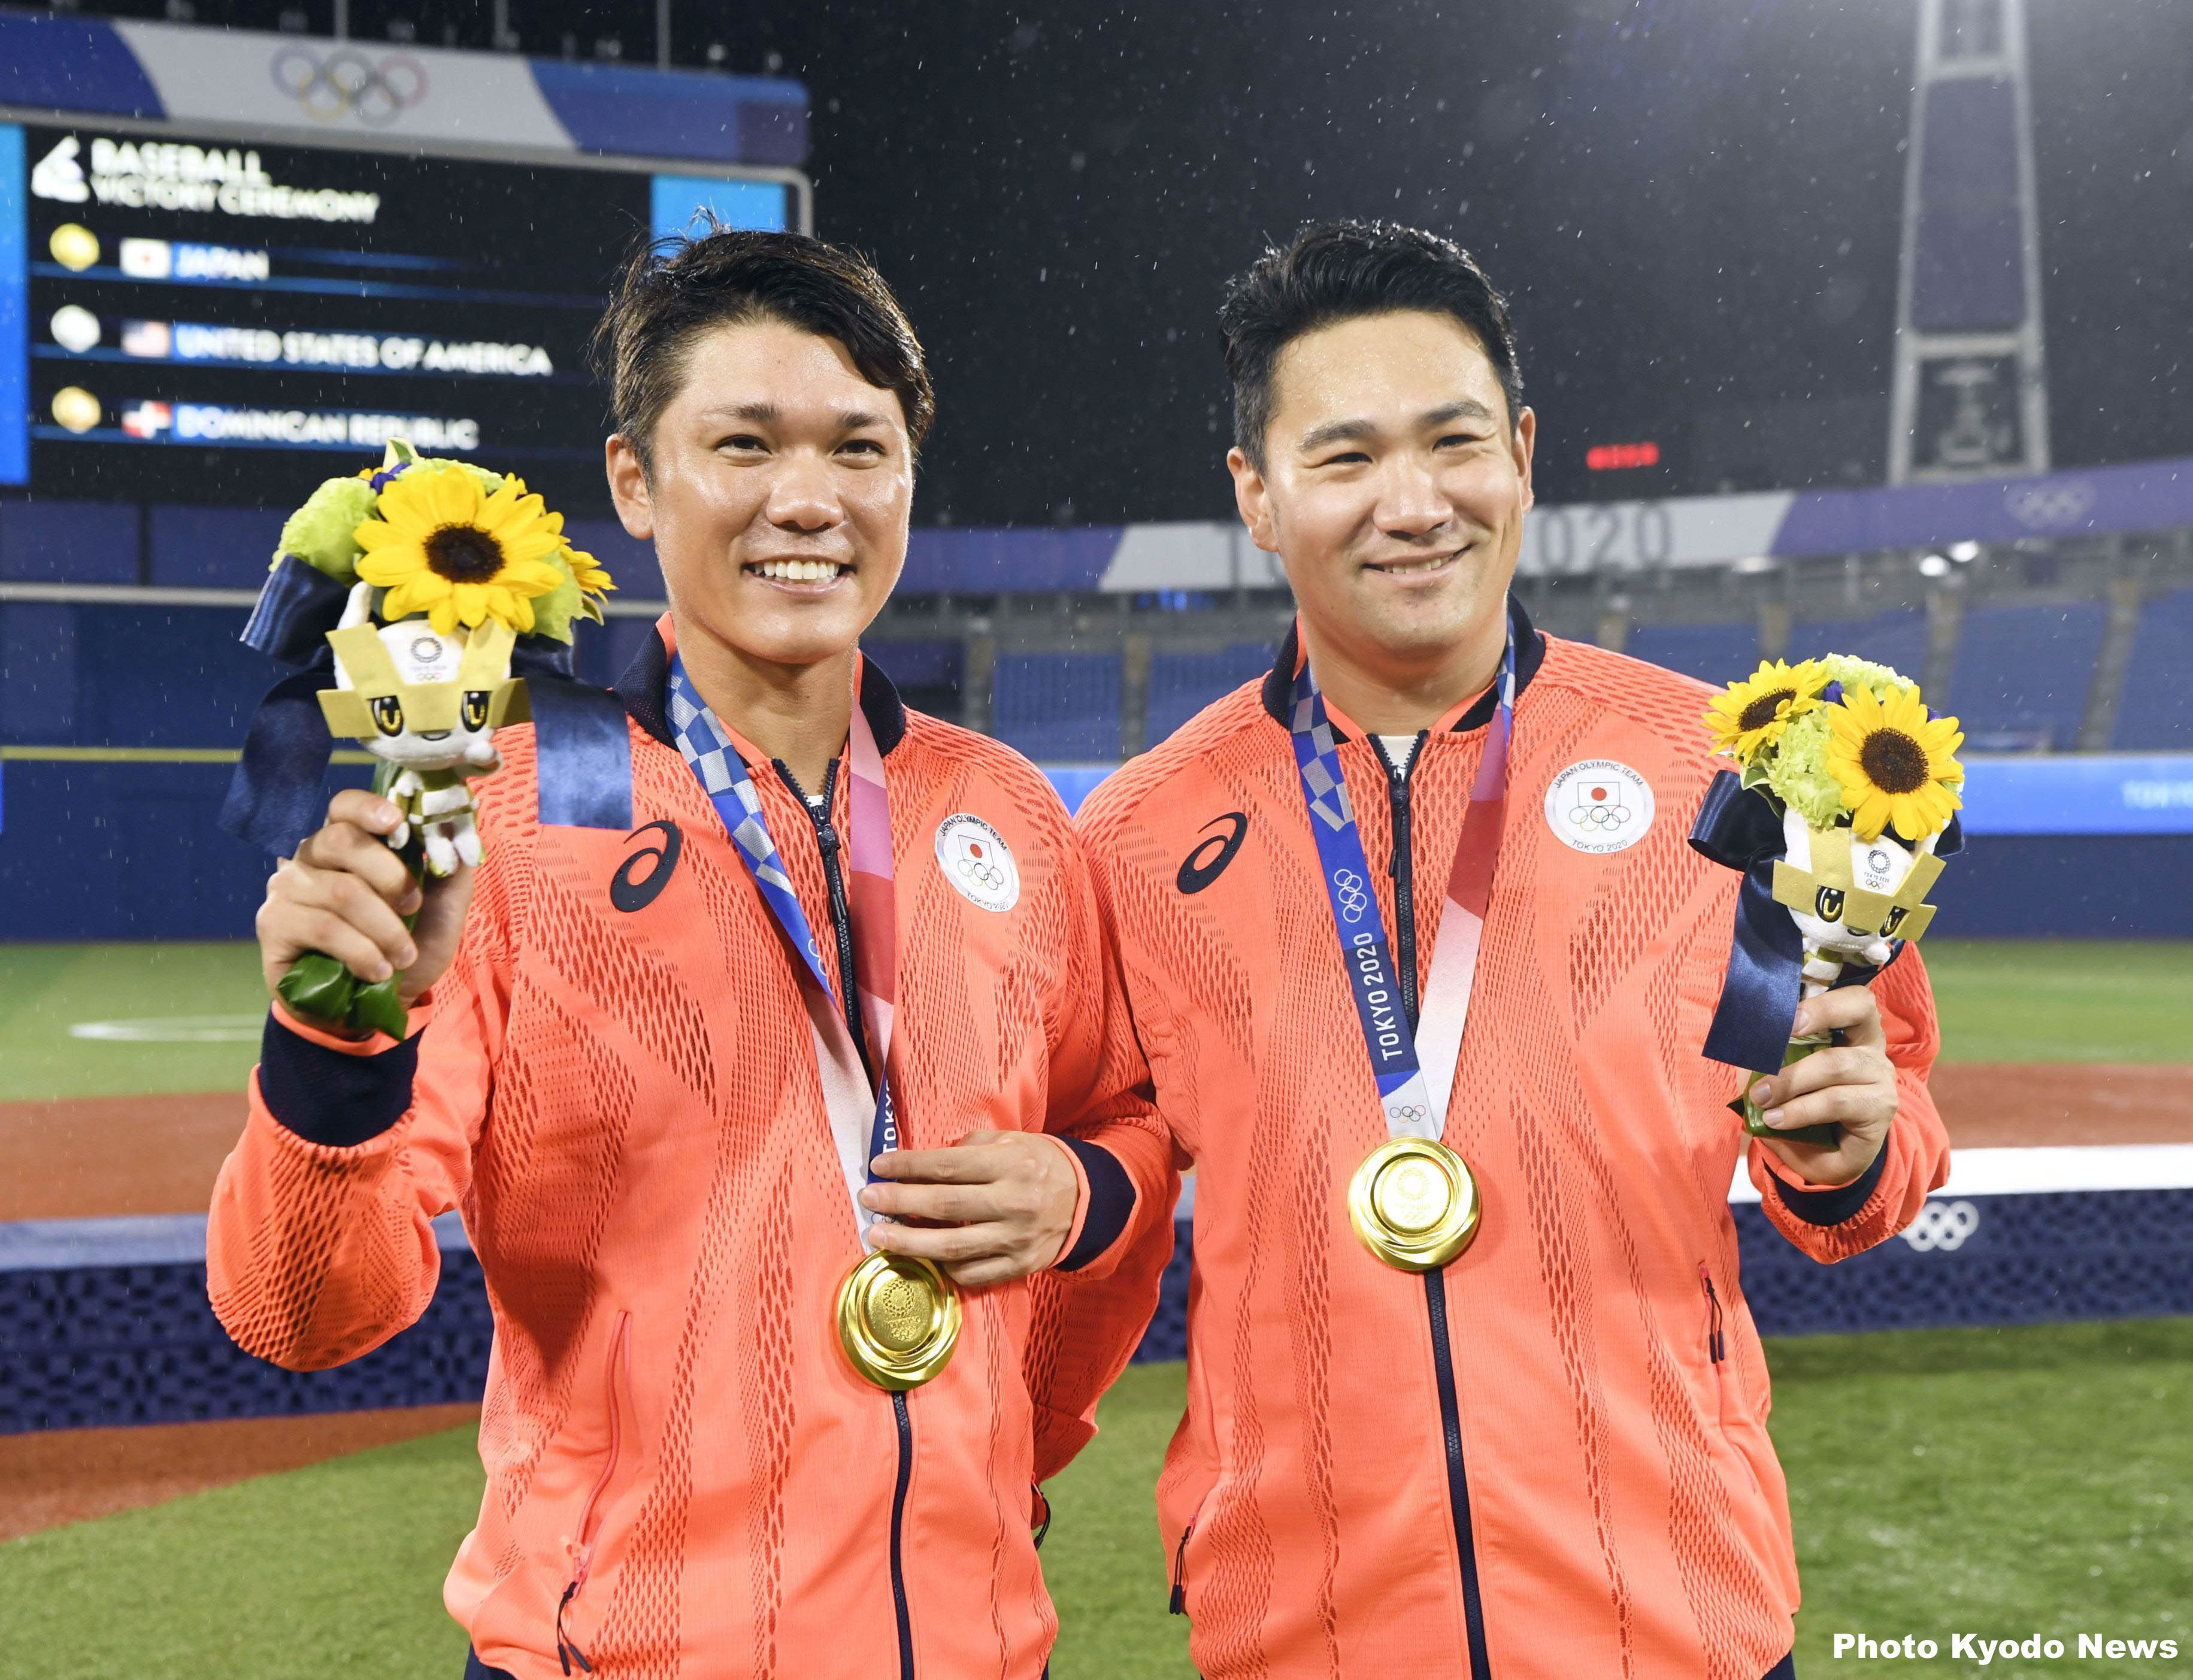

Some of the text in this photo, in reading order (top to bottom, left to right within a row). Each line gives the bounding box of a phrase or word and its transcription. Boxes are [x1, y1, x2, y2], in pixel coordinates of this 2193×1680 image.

[91, 138, 271, 186] BASEBALL
[90, 174, 380, 224] VICTORY CEREMONY
[177, 246, 269, 281] JAPAN
[176, 326, 553, 376] UNITED STATES OF AMERICA
[176, 405, 479, 450] DOMINICAN REPUBLIC
[1538, 504, 1671, 573] 020
[1555, 761, 1644, 789] JAPAN OLYMPIC TEAM
[939, 815, 1007, 850] JAPAN OLYMPIC TEAM
[1572, 839, 1628, 852] TOKYO 2020
[1353, 932, 1403, 1061] TOKYO 2020
[883, 1079, 898, 1153] TOKY
